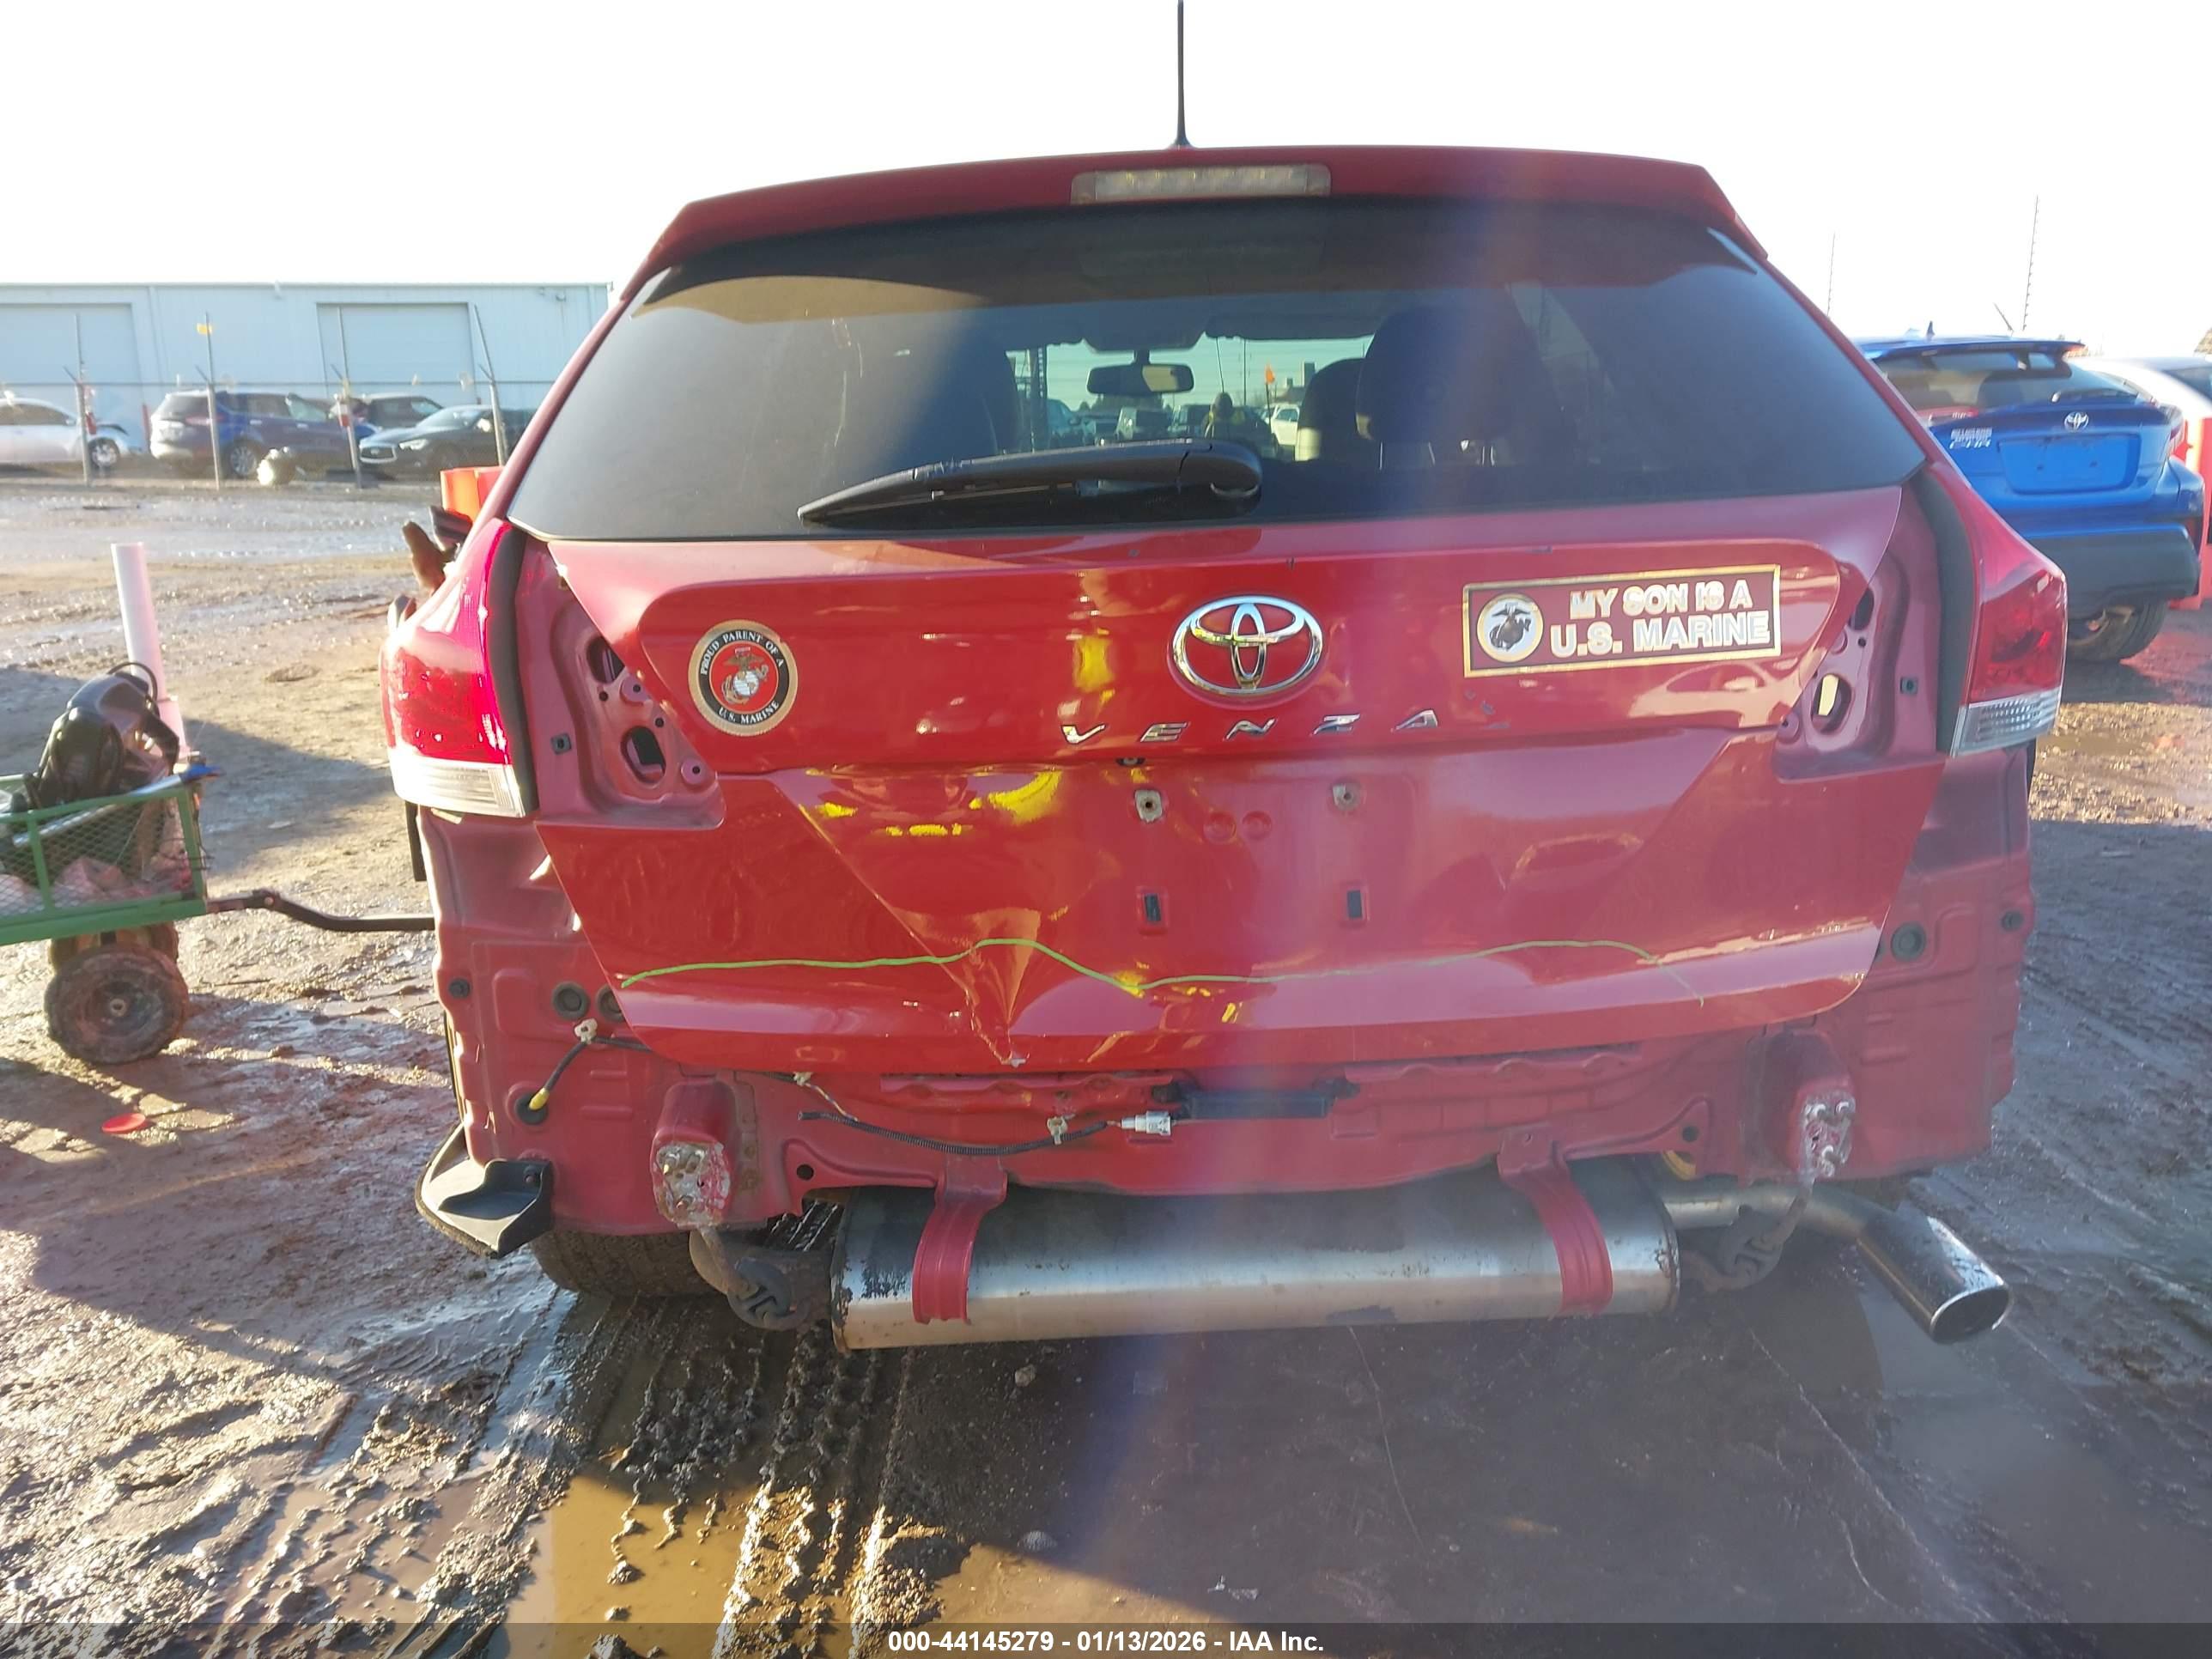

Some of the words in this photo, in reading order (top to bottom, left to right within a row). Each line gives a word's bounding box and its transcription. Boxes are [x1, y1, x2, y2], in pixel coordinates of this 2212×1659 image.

[1569, 587, 1618, 620] MY
[1622, 581, 1688, 616] SON
[1694, 580, 1725, 611] IS
[1729, 580, 1753, 609] A
[700, 641, 720, 676] PROUD
[722, 630, 763, 642] PARENT
[765, 639, 779, 656] OF
[776, 658, 784, 668] A
[1550, 620, 1622, 658] U.S.
[1632, 611, 1771, 652] MARINE
[718, 707, 736, 723] U.S.
[740, 700, 780, 724] MARINE
[1060, 708, 1438, 745] VENZA
